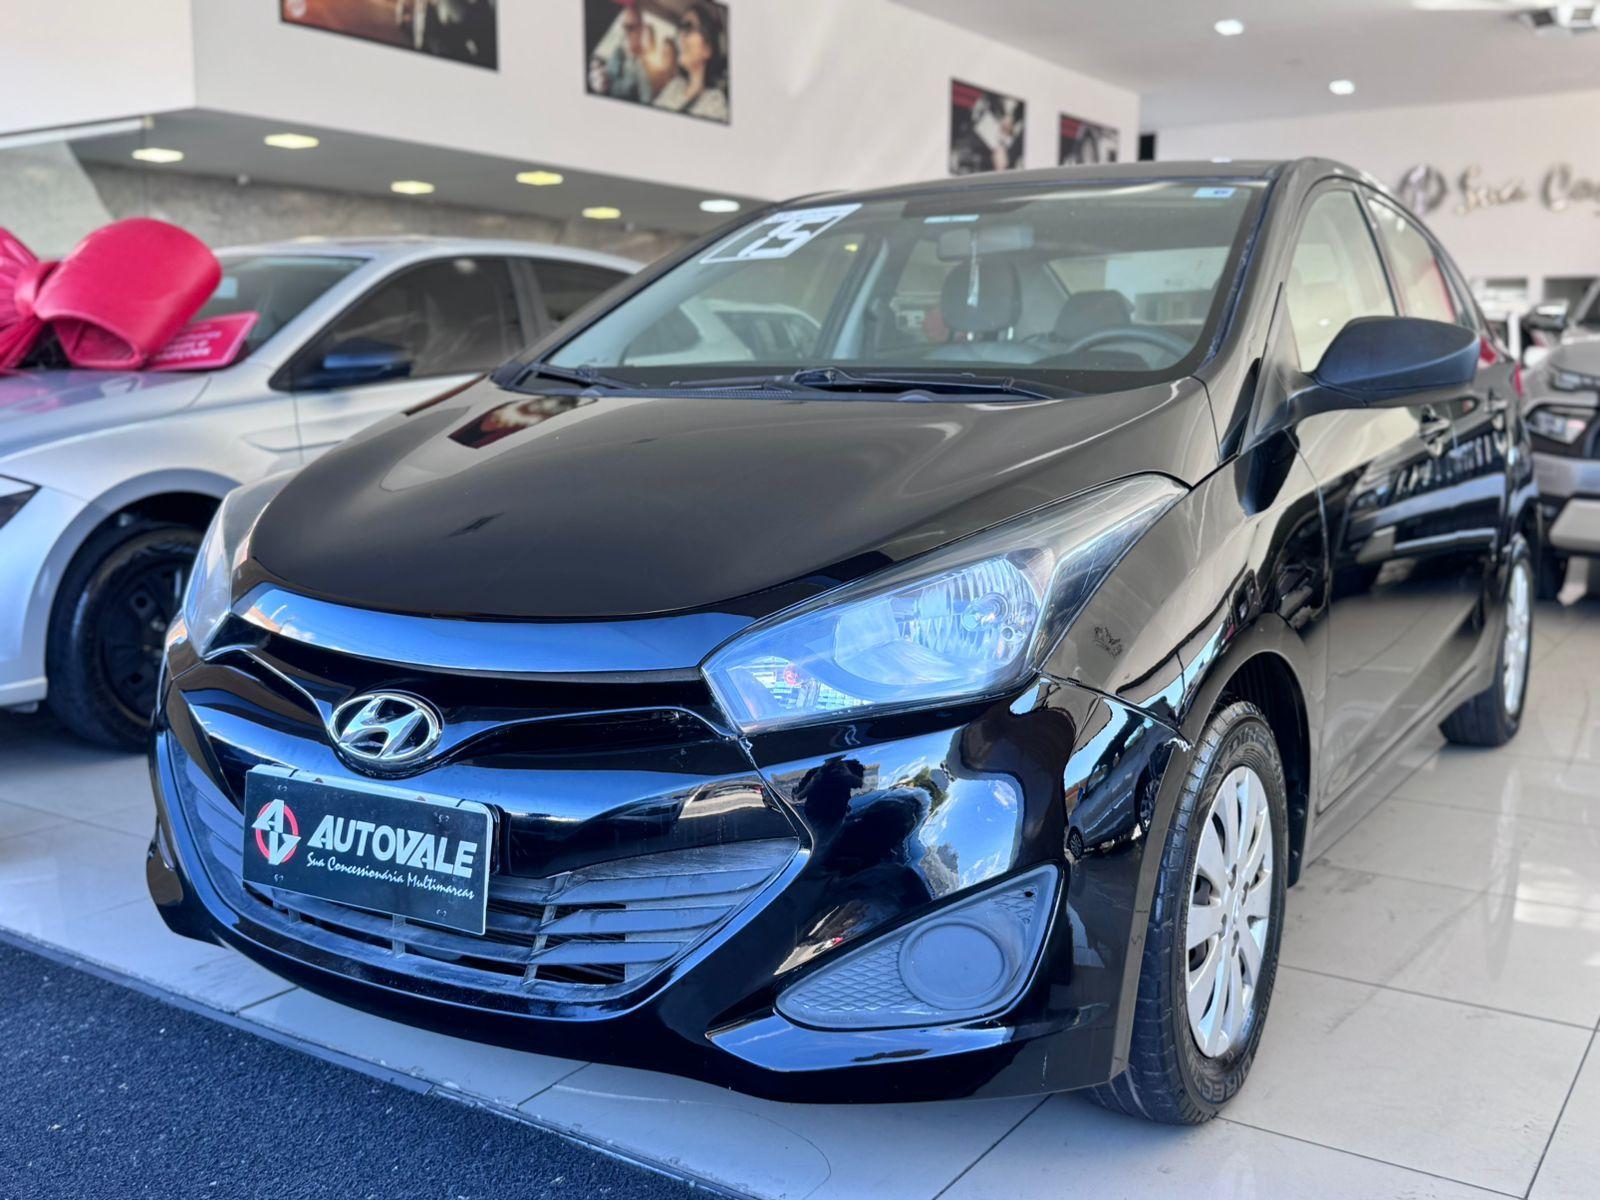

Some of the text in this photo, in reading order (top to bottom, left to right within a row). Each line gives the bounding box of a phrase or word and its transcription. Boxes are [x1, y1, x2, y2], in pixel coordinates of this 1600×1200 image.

[307, 814, 477, 879] AUTOVALE
[306, 852, 475, 899] Sua Concessionária Multimarcas
